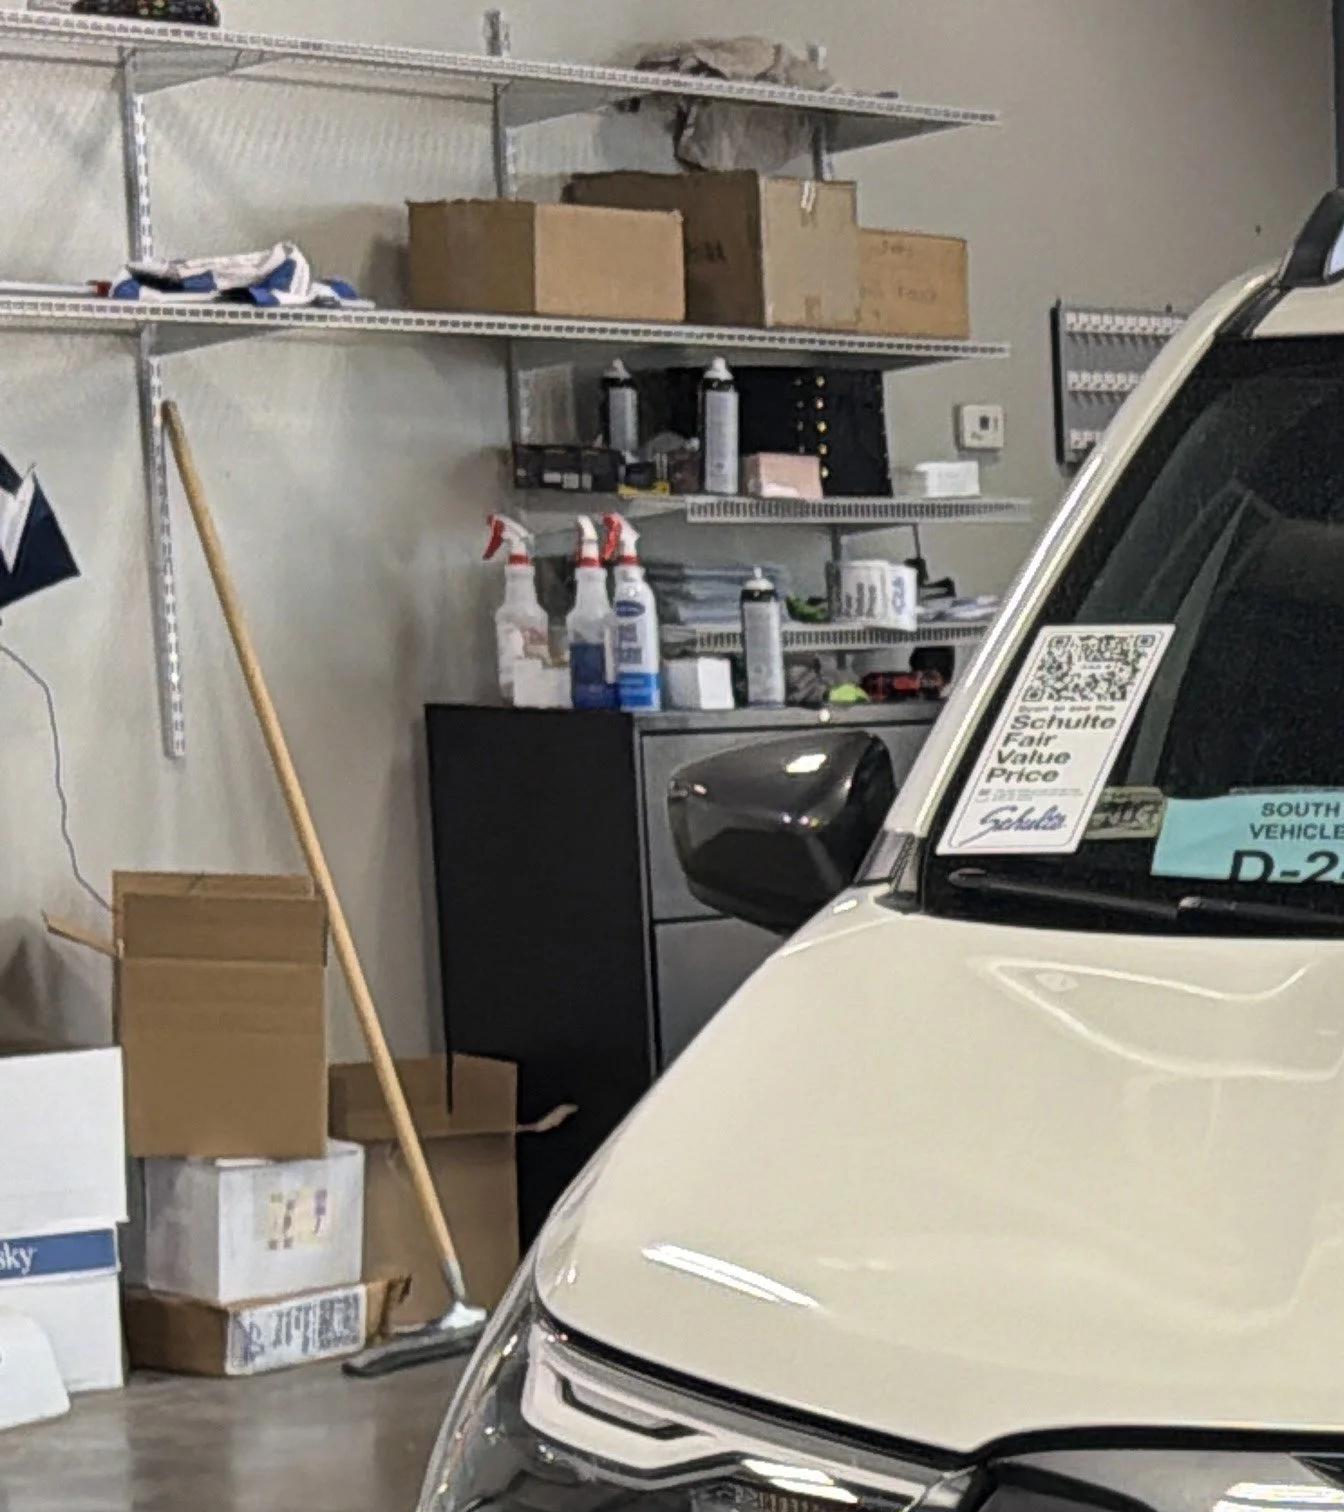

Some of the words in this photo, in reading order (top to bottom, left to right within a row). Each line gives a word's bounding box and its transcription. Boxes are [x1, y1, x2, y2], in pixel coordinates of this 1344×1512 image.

[1010, 713, 1117, 730] Schulte
[1003, 731, 1058, 748] Fair
[996, 749, 1072, 766] Value
[985, 766, 1060, 784] Price
[1260, 801, 1340, 818] SOUTH
